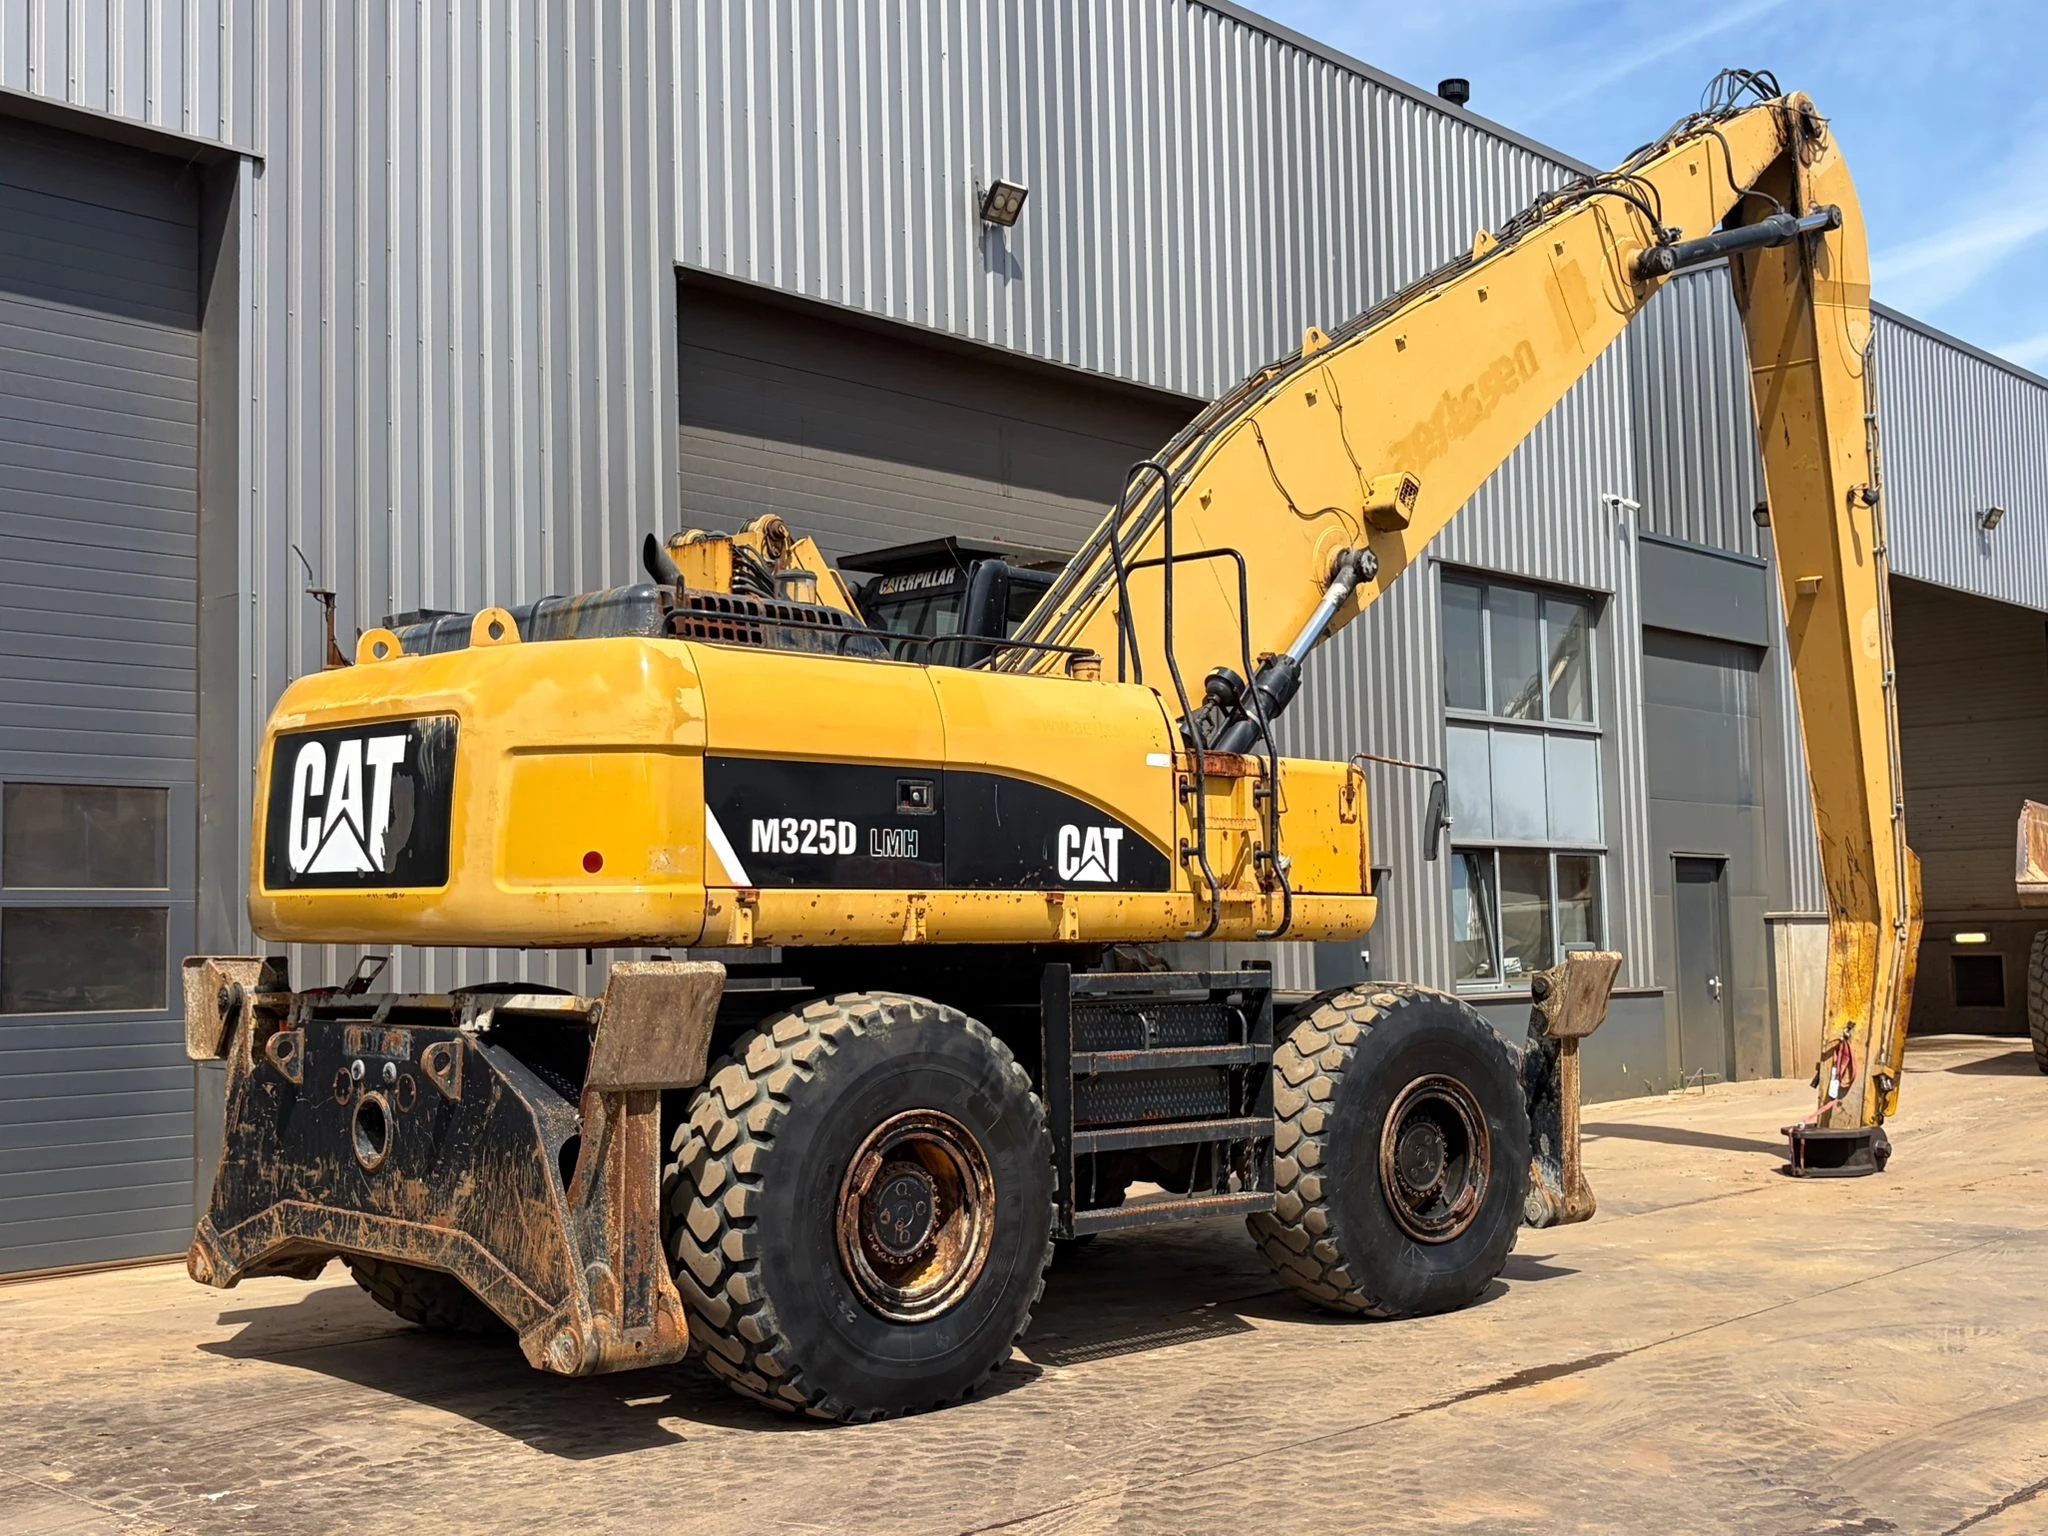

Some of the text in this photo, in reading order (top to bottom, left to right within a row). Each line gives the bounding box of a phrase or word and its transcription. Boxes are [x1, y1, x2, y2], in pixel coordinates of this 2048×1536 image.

[879, 568, 956, 595] CATERPILLAR
[289, 735, 407, 874] CAT
[752, 817, 919, 858] M325D LMH
[1058, 824, 1124, 883] CAT
